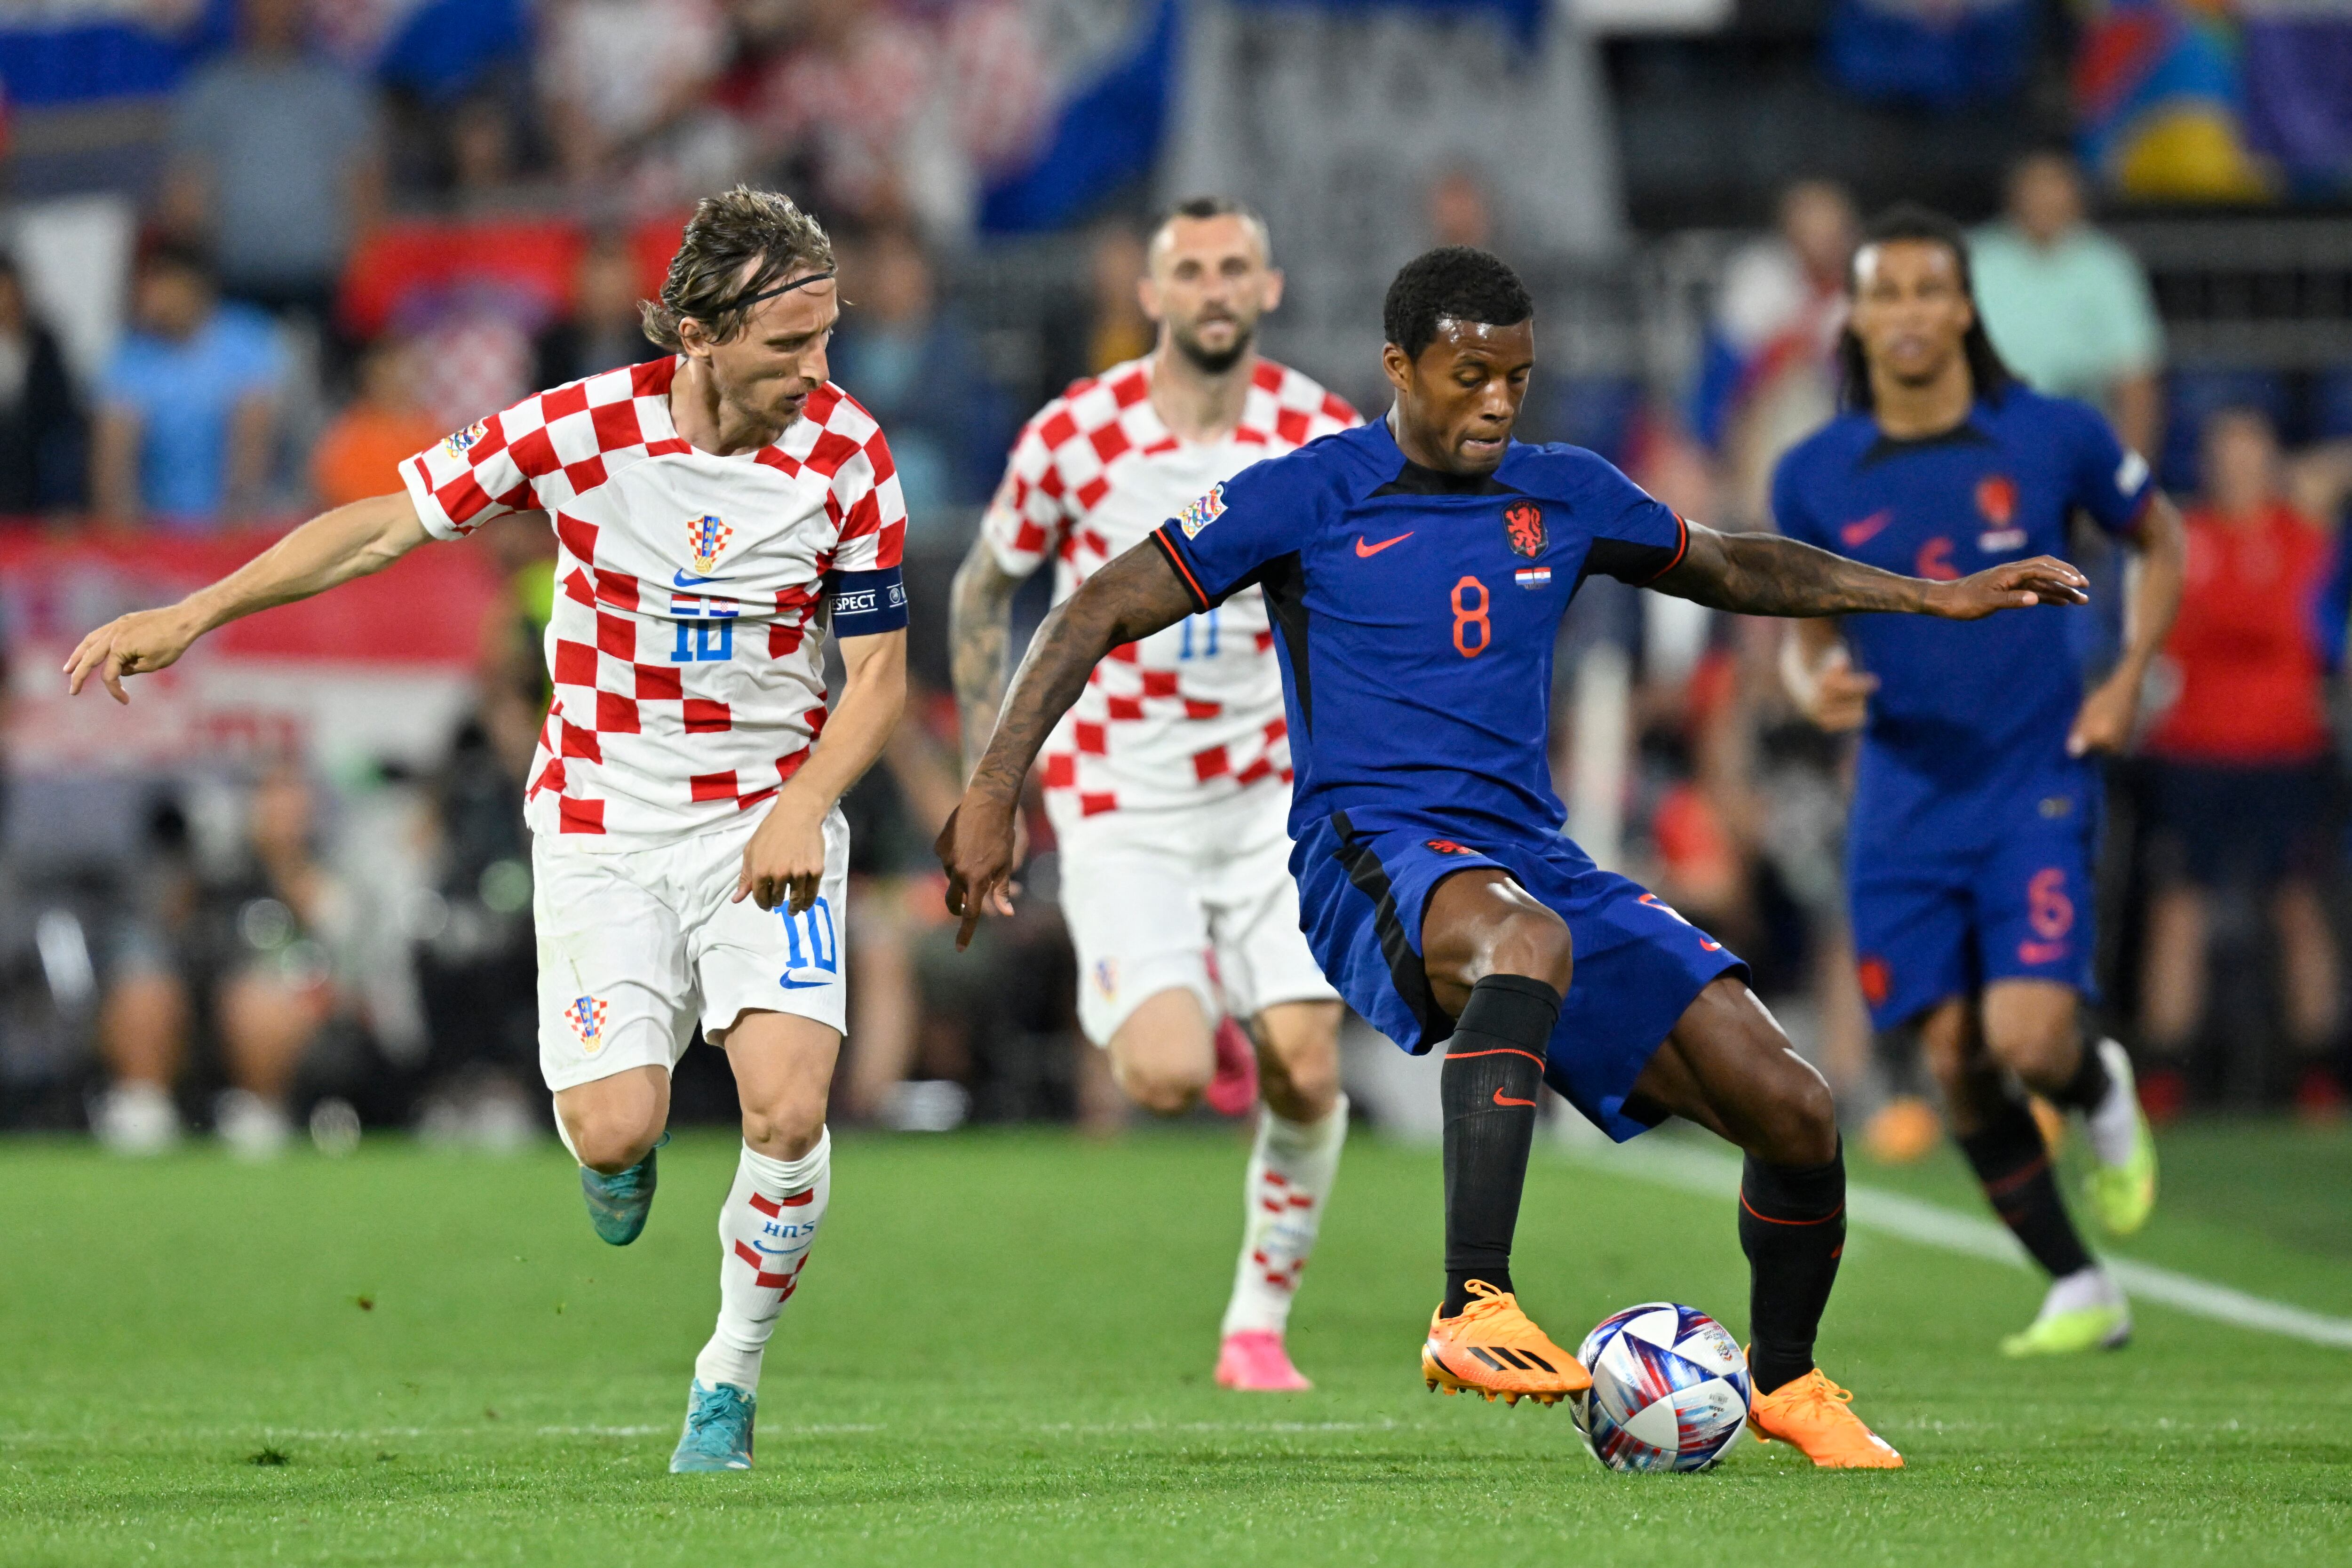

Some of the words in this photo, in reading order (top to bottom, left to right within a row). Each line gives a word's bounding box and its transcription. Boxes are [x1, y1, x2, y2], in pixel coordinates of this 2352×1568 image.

[704, 520, 715, 550] HNS
[832, 594, 876, 611] ESPECT
[1451, 575, 1491, 658] 8
[671, 619, 732, 661] 10
[1179, 607, 1219, 660] 11
[2028, 868, 2074, 940] 6
[773, 896, 836, 974] 10
